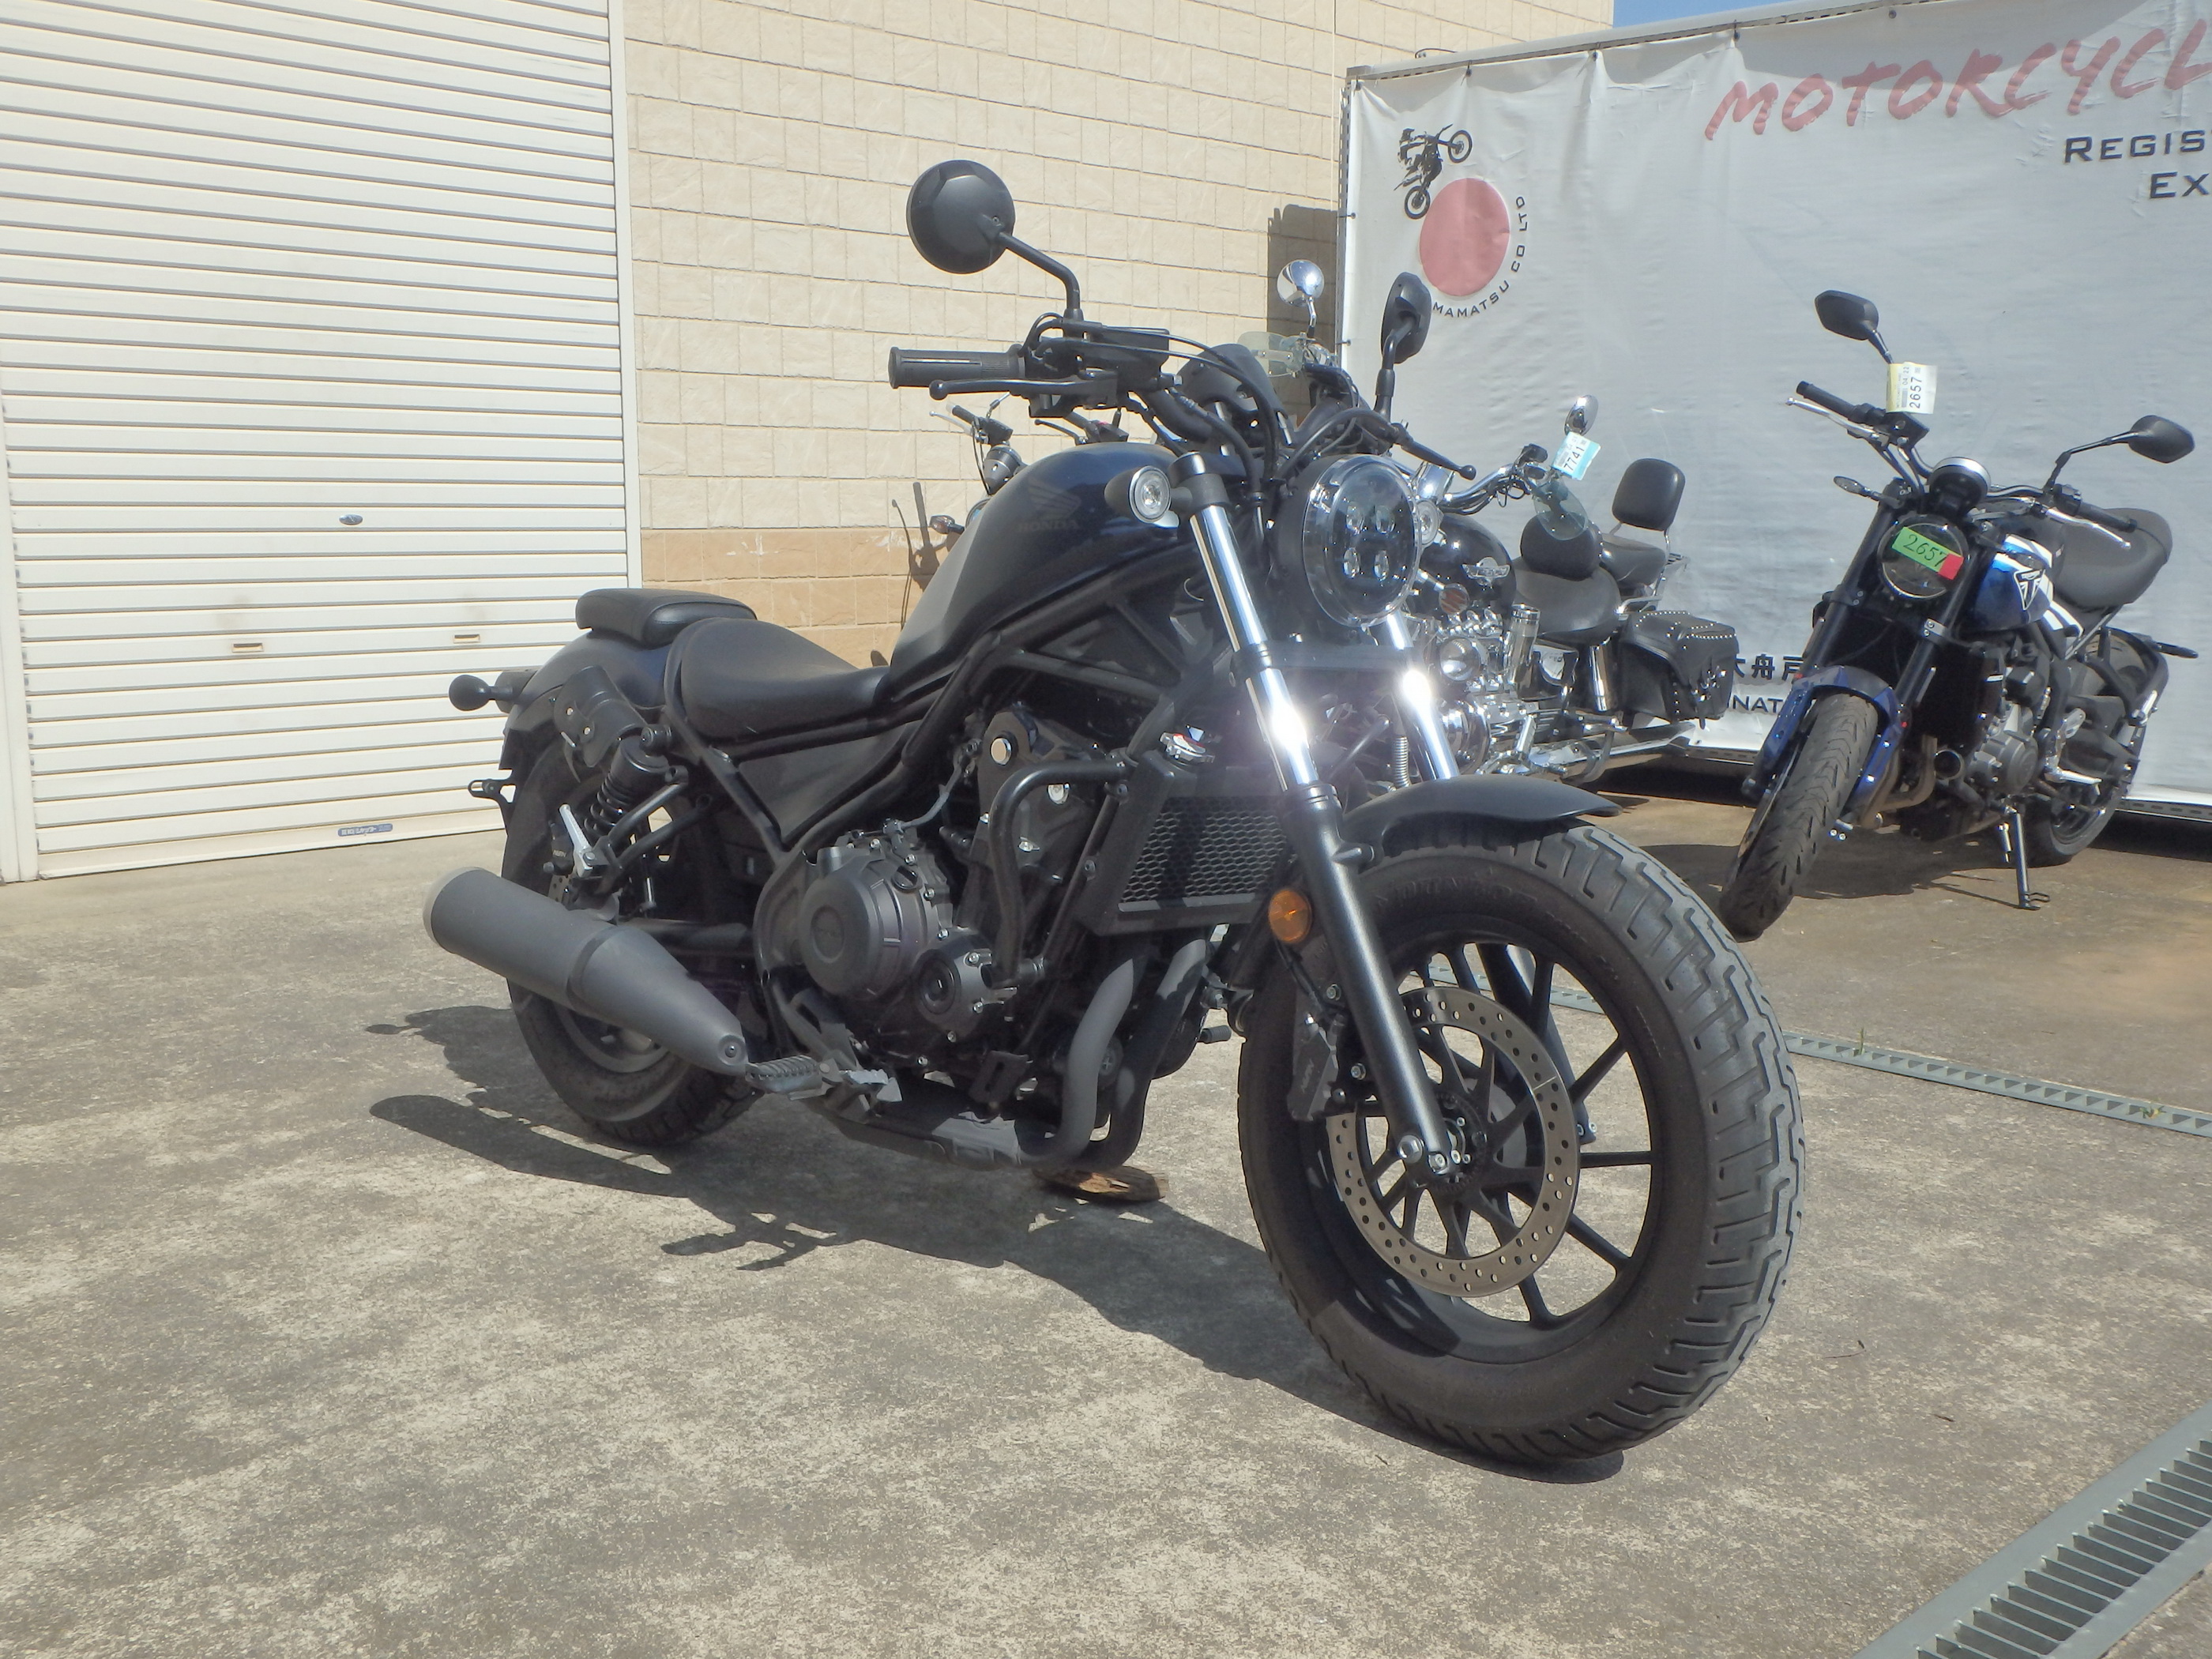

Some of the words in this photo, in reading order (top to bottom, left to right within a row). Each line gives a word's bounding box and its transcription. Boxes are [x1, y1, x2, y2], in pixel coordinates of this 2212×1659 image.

[2064, 129, 2212, 164] REGIS
[2150, 171, 2210, 199] EX
[1515, 197, 1528, 231] LTD
[1511, 245, 1525, 272] CO
[1433, 280, 1510, 318] MAMATSU
[1909, 377, 1922, 409] 2657
[1563, 446, 1585, 471] 7741
[1903, 534, 1947, 567] 2657
